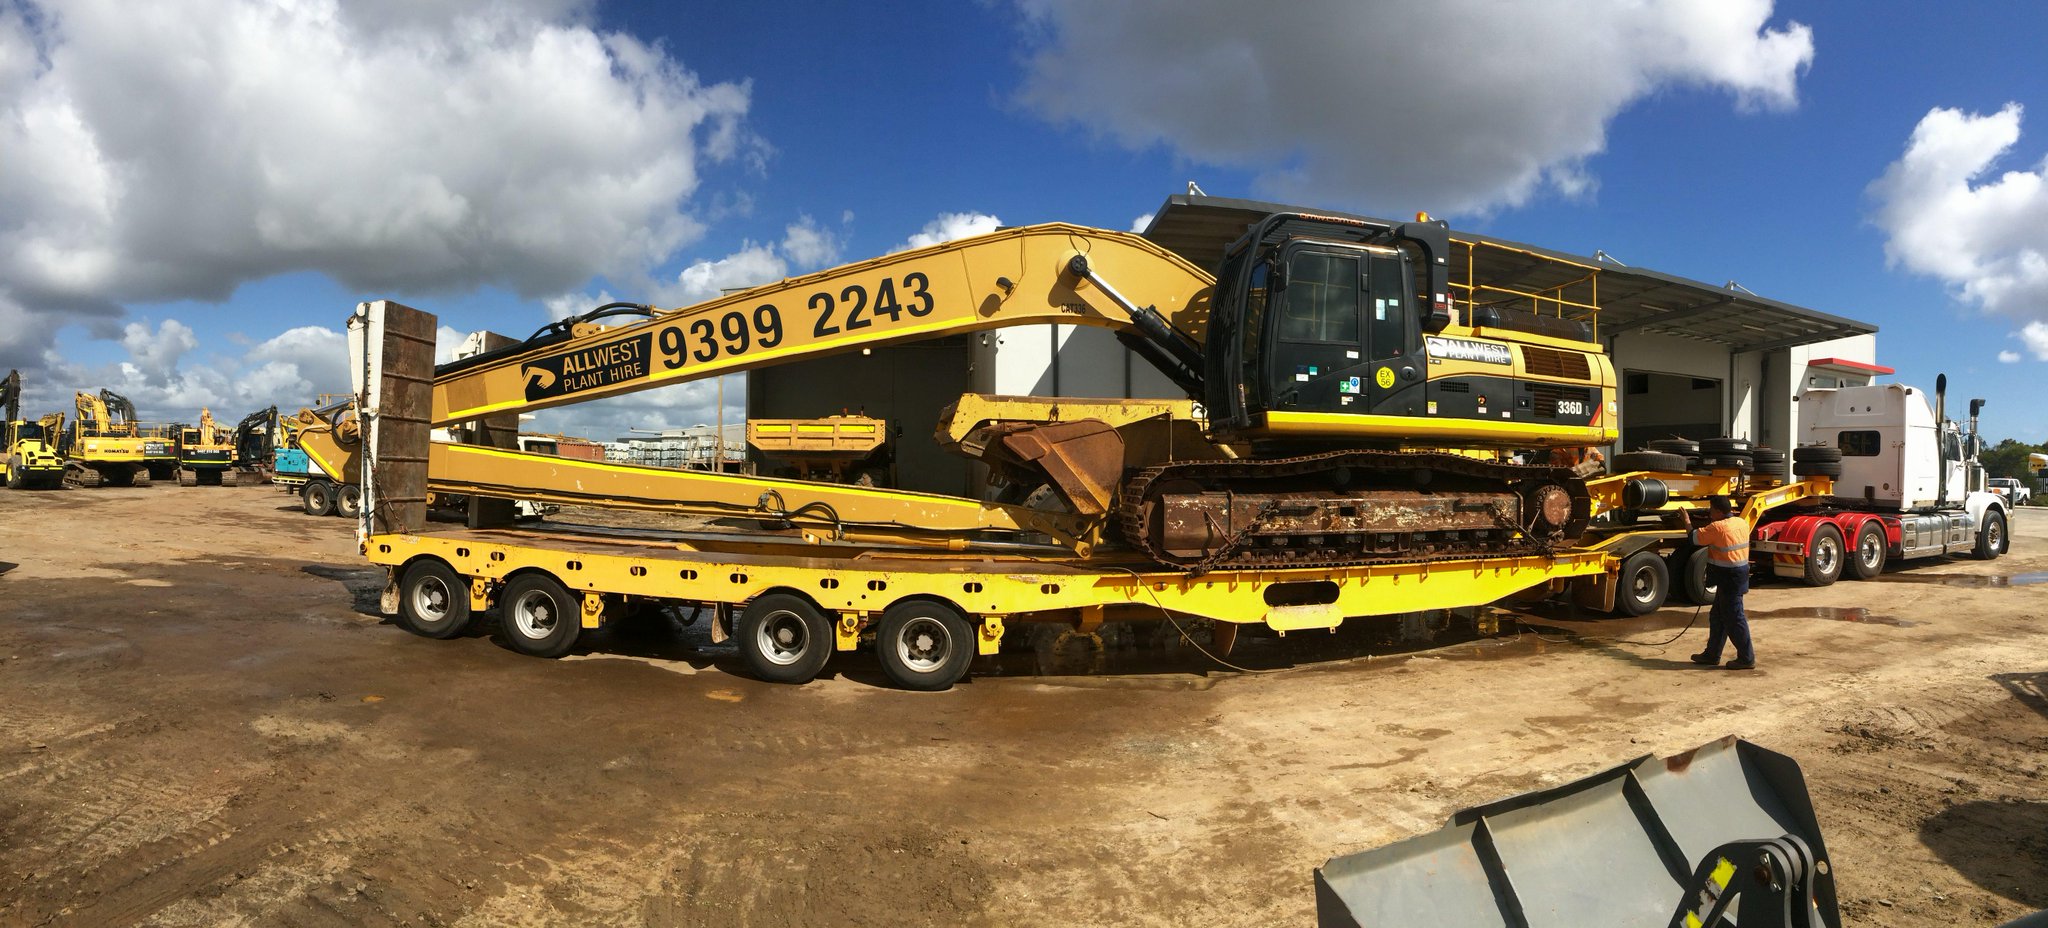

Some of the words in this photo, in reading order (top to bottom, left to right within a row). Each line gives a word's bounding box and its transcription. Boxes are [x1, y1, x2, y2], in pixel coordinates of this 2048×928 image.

[1061, 303, 1086, 314] CAT336
[658, 303, 783, 370] 9399
[808, 271, 935, 338] 2243
[1447, 340, 1506, 354] ALLWEST
[563, 339, 641, 376] ALLWEST
[1449, 351, 1480, 361] PLANT
[1484, 354, 1507, 364] HIRE
[563, 370, 604, 392] PLANT
[609, 362, 643, 382] HIRE
[1380, 370, 1391, 378] EX
[1380, 379, 1391, 387] 56
[1557, 400, 1583, 415] 336D
